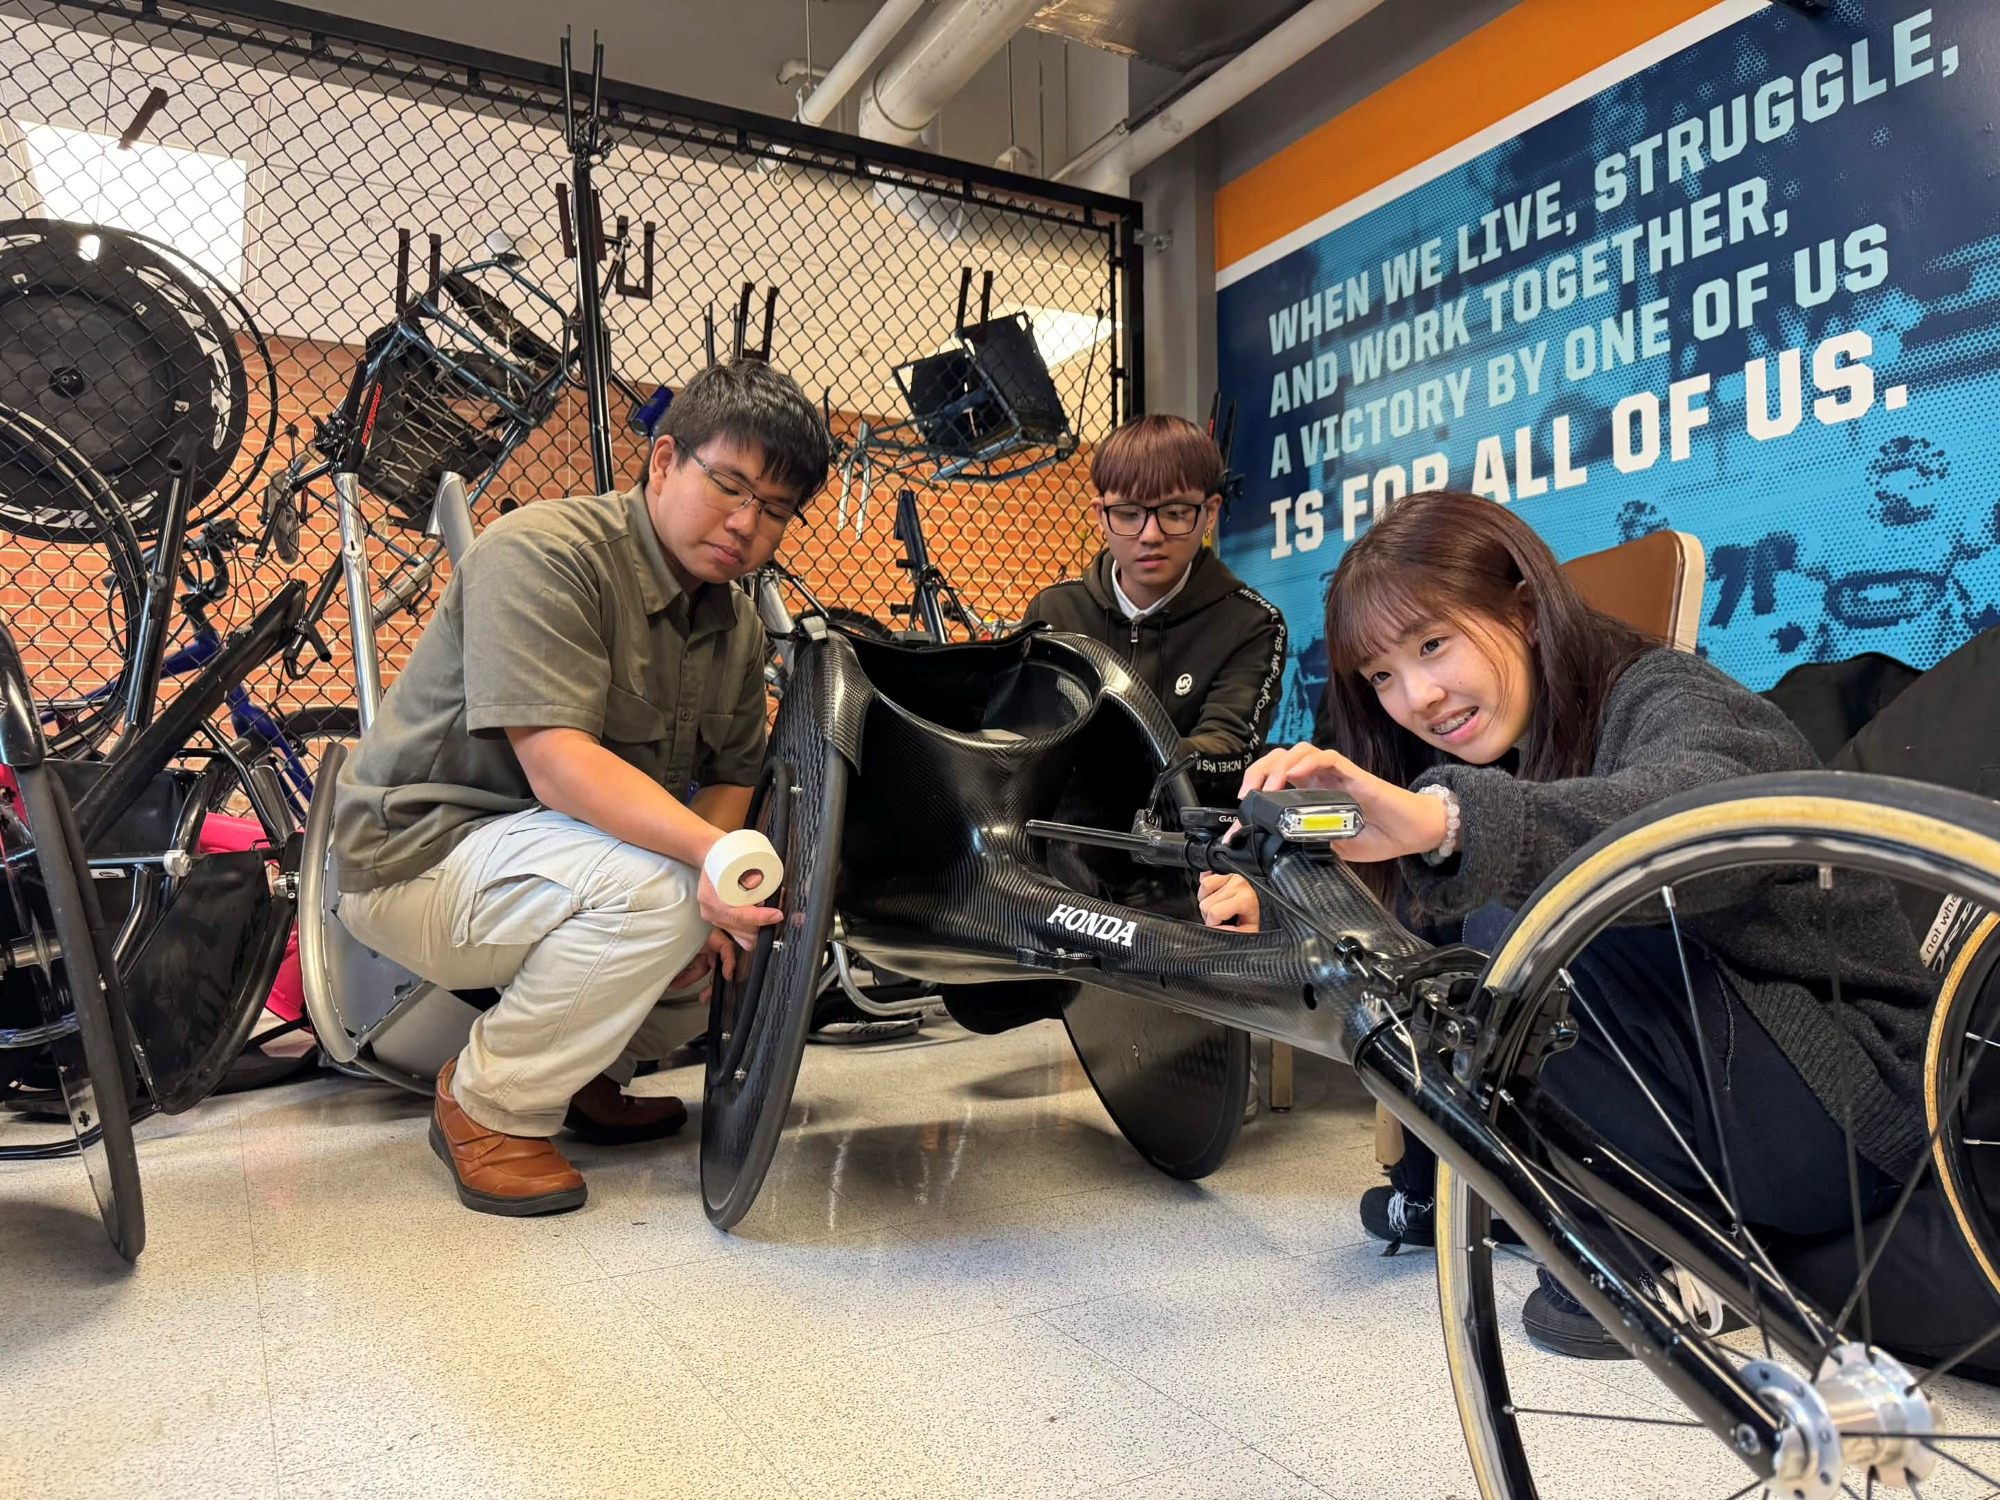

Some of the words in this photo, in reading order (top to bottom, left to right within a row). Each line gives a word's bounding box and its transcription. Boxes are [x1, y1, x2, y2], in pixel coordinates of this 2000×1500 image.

[1269, 270, 1370, 355] WHEN
[1382, 237, 1442, 304] WE
[1458, 180, 1576, 274] LIVE,
[1595, 9, 1958, 212] STRUGGLE,
[1270, 352, 1337, 417] AND
[1350, 296, 1470, 386] WORK
[1483, 177, 1788, 333] TOGETHER,
[1270, 433, 1291, 479] A
[1300, 367, 1471, 468] VICTORY
[1488, 340, 1547, 407] BY
[1565, 297, 1670, 381] ONE
[1693, 262, 1768, 341] OF
[1794, 223, 1888, 308] US
[1270, 489, 1324, 560] IS
[1471, 414, 1587, 503] ALL
[1612, 373, 1710, 474] OF
[1745, 330, 1907, 441] US.
[1239, 588, 1279, 623] MICHAEL
[1046, 903, 1138, 947] HONDA
